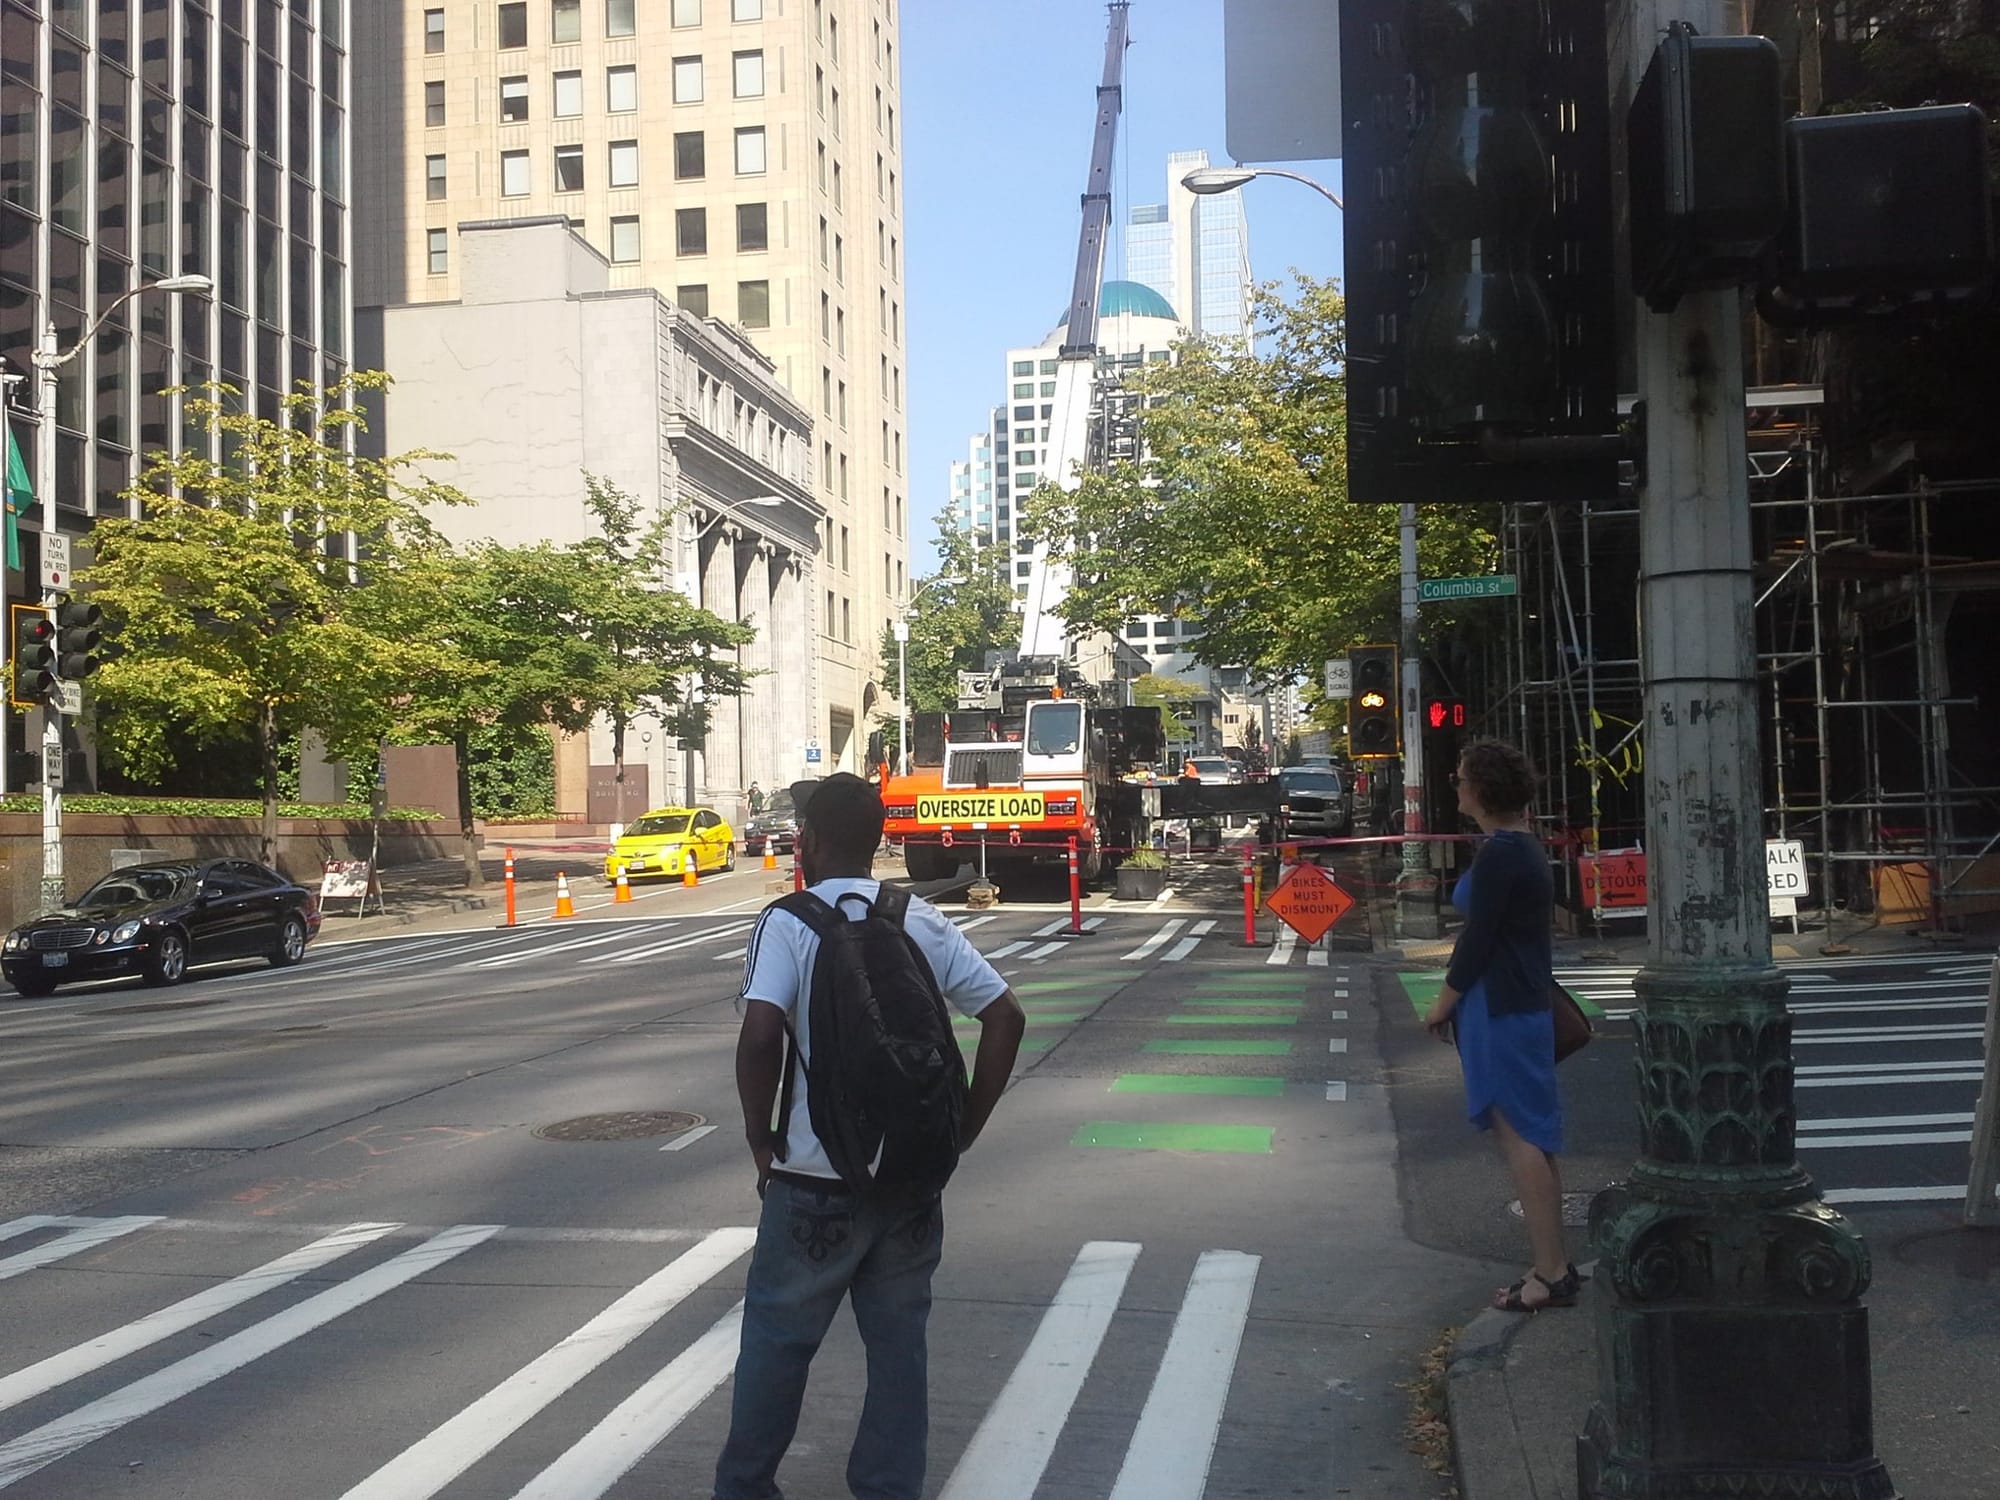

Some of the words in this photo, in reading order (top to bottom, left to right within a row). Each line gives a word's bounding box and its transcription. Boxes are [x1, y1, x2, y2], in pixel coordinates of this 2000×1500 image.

[49, 537, 62, 549] NO
[47, 549, 65, 560] TURN
[43, 560, 53, 569] ON
[55, 562, 68, 572] RED
[1423, 580, 1484, 597] Columbia
[1488, 582, 1500, 593] St
[48, 746, 61, 757] ONE
[48, 758, 61, 769] WAY
[919, 799, 995, 818] OVERSIZE
[1000, 798, 1041, 817] LOAD
[1291, 877, 1325, 888] BIKES
[1585, 874, 1647, 889] DETOUR
[1293, 891, 1325, 901] MUST
[1280, 904, 1340, 915] DISMOUNT
